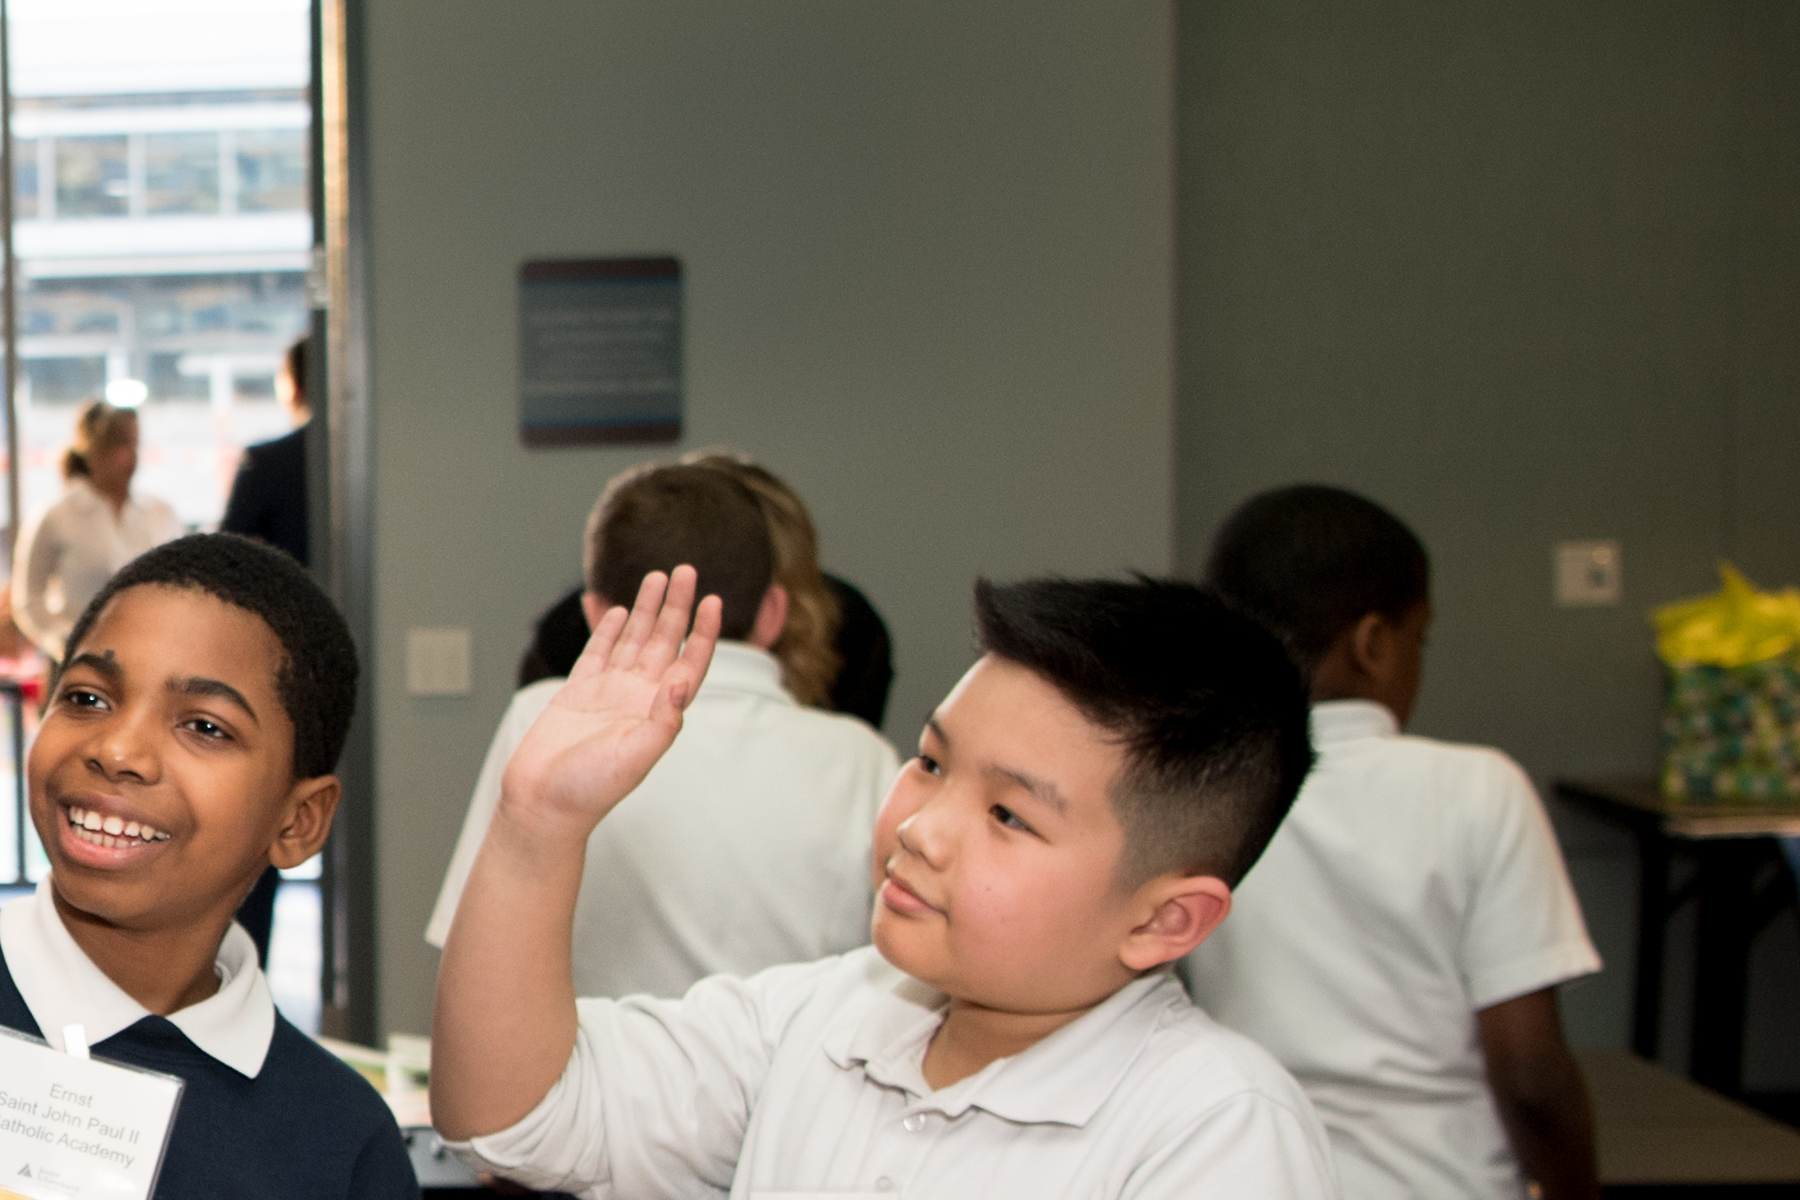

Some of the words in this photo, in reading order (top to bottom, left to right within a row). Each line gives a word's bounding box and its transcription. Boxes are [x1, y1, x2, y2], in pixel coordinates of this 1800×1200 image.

[50, 1083, 93, 1108] Ernst
[41, 1106, 82, 1128] John
[86, 1117, 125, 1140] Paul
[129, 1130, 140, 1145] II
[56, 1133, 135, 1169] Academy
